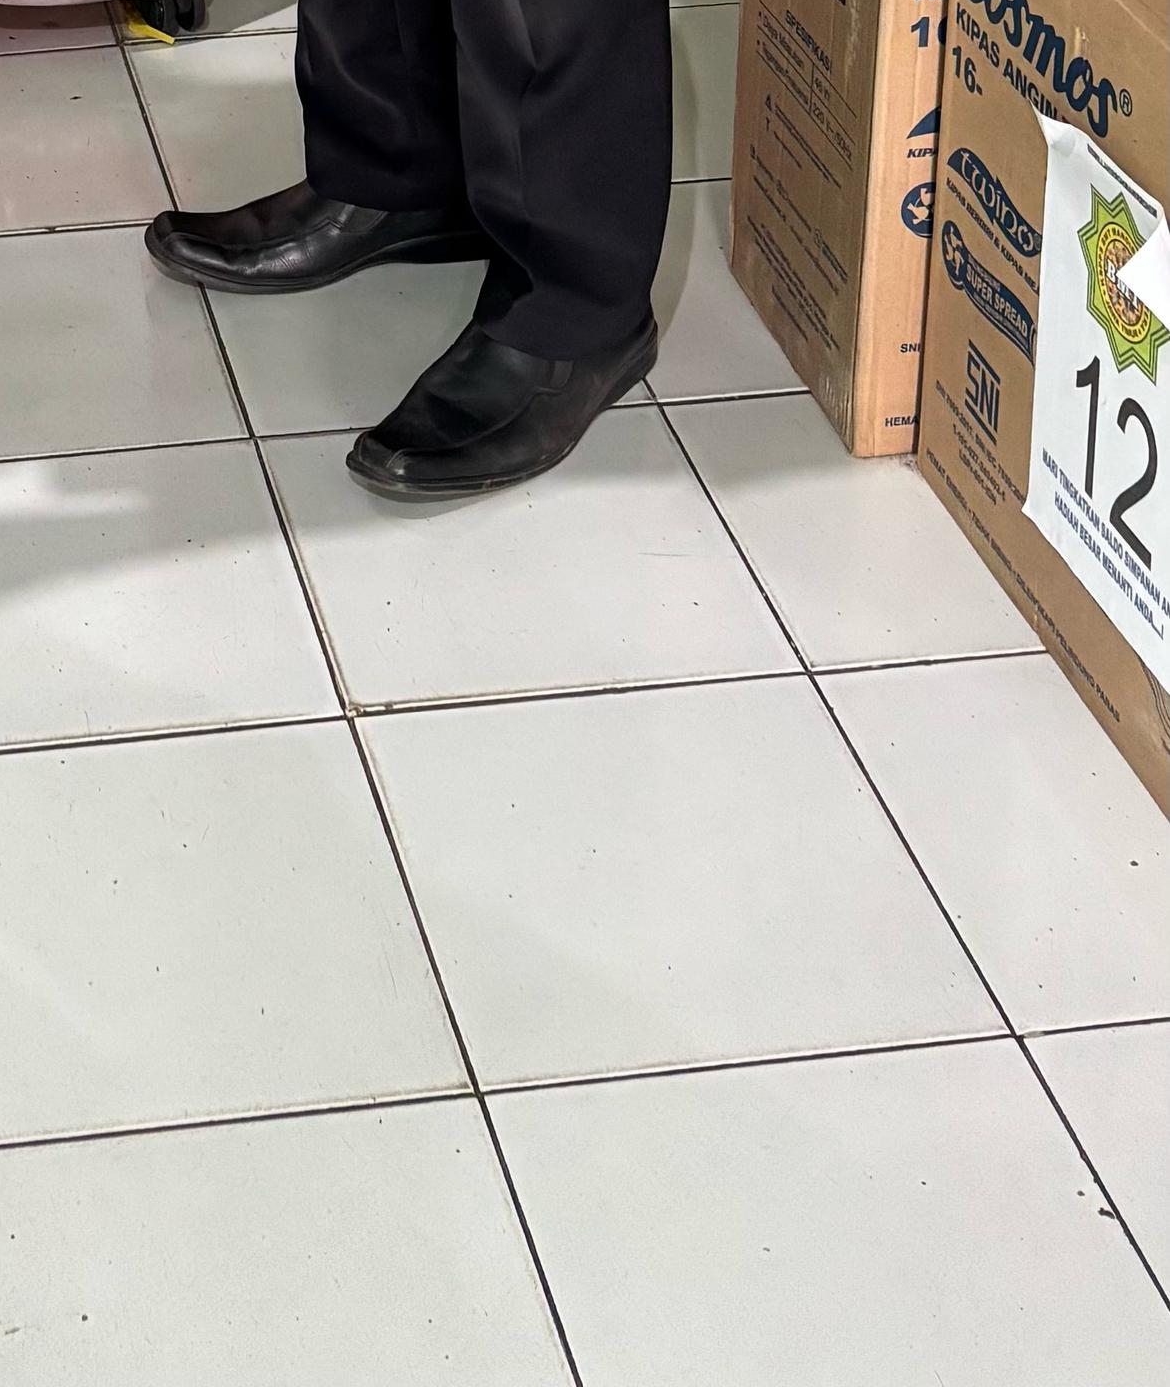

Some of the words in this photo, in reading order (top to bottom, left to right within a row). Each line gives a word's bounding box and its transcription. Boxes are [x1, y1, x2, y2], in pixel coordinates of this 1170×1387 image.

[956, 2, 1000, 68] KIPAS
[1002, 58, 1058, 118] ANGIN
[947, 177, 966, 207] KIPAS
[1000, 240, 1024, 277] KIPAS
[966, 266, 993, 307] SUPER
[993, 288, 1028, 338] SPREAD
[965, 350, 1001, 433] SNI
[1076, 355, 1157, 572] 12
[1042, 447, 1058, 480] MARI
[1059, 467, 1100, 533] TINGKATKAN
[1101, 520, 1123, 561] SALDO
[1124, 549, 1161, 602] SIMPANAN
[1054, 490, 1080, 535] HADIAH
[1079, 523, 1101, 562] BESAR
[1102, 548, 1133, 600] MENANTI
